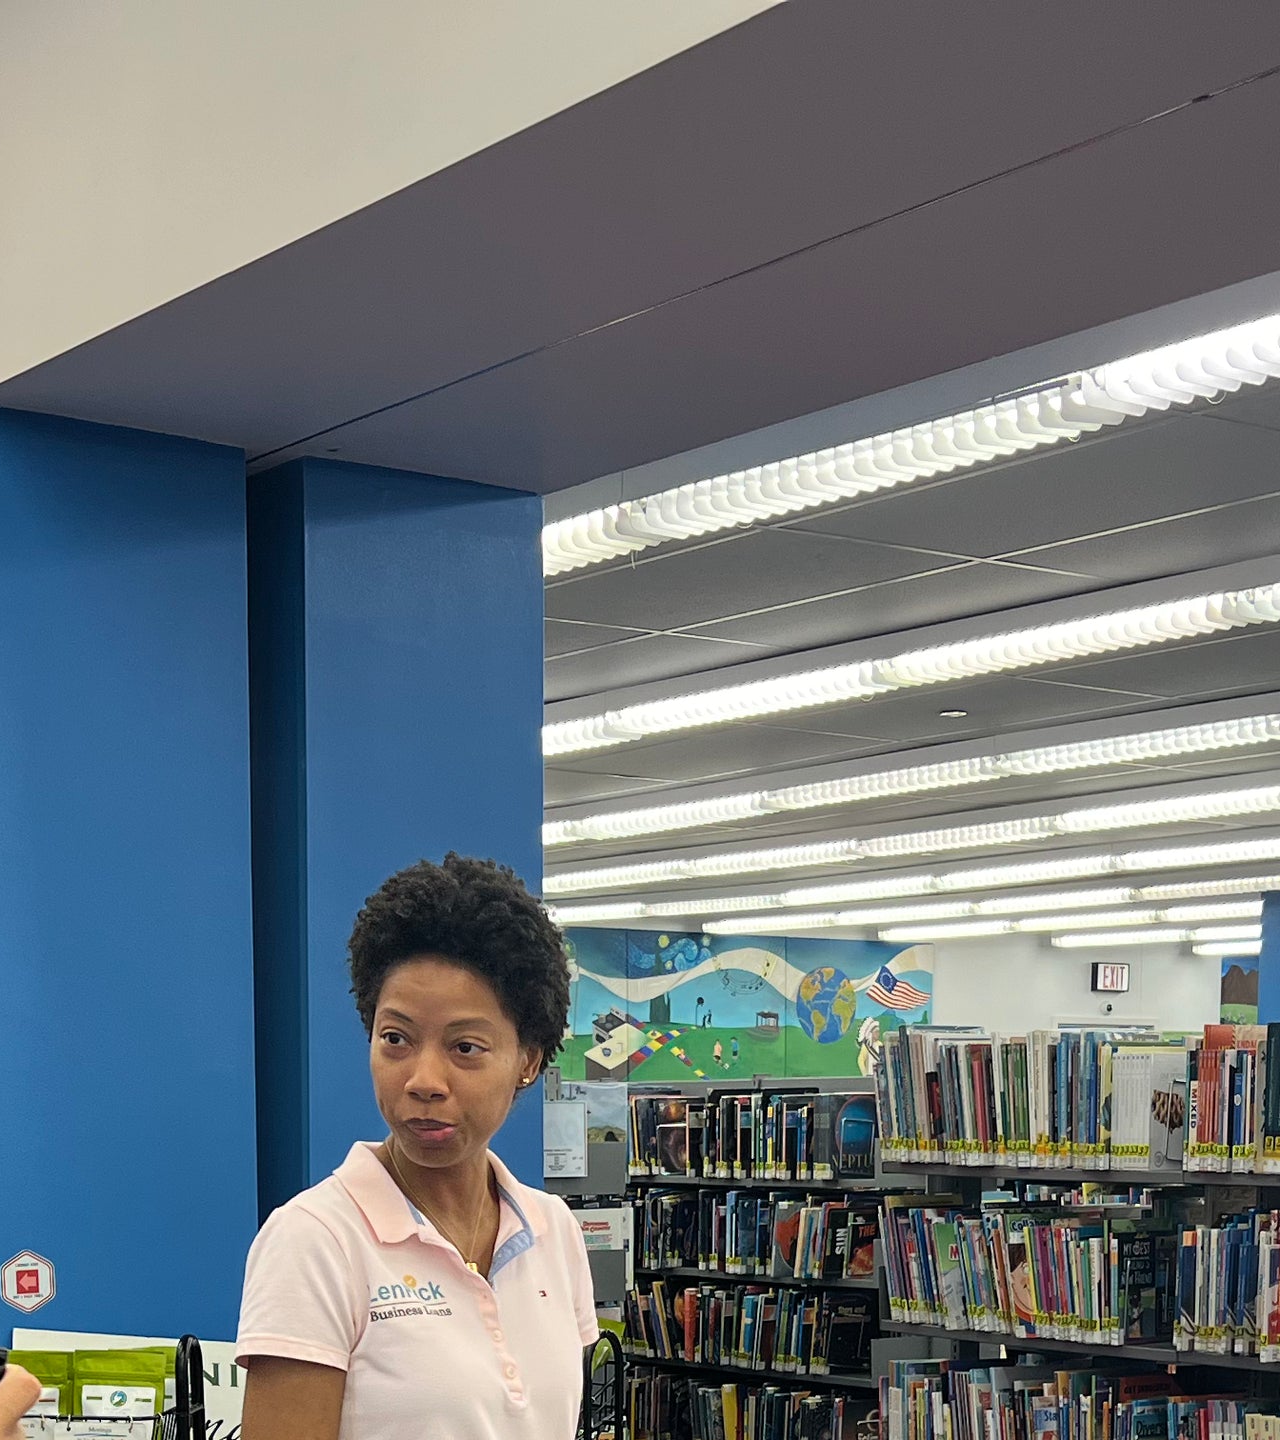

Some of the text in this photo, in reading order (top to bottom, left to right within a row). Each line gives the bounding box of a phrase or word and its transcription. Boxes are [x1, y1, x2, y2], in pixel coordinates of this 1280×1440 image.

[1103, 966, 1125, 988] EXIT
[1190, 1088, 1199, 1129] MIXED
[832, 1153, 871, 1169] NEPTU
[1011, 1216, 1051, 1232] Collabo
[835, 1228, 848, 1254] SUN
[370, 1306, 423, 1322] Business
[1135, 1419, 1166, 1437] Divers
